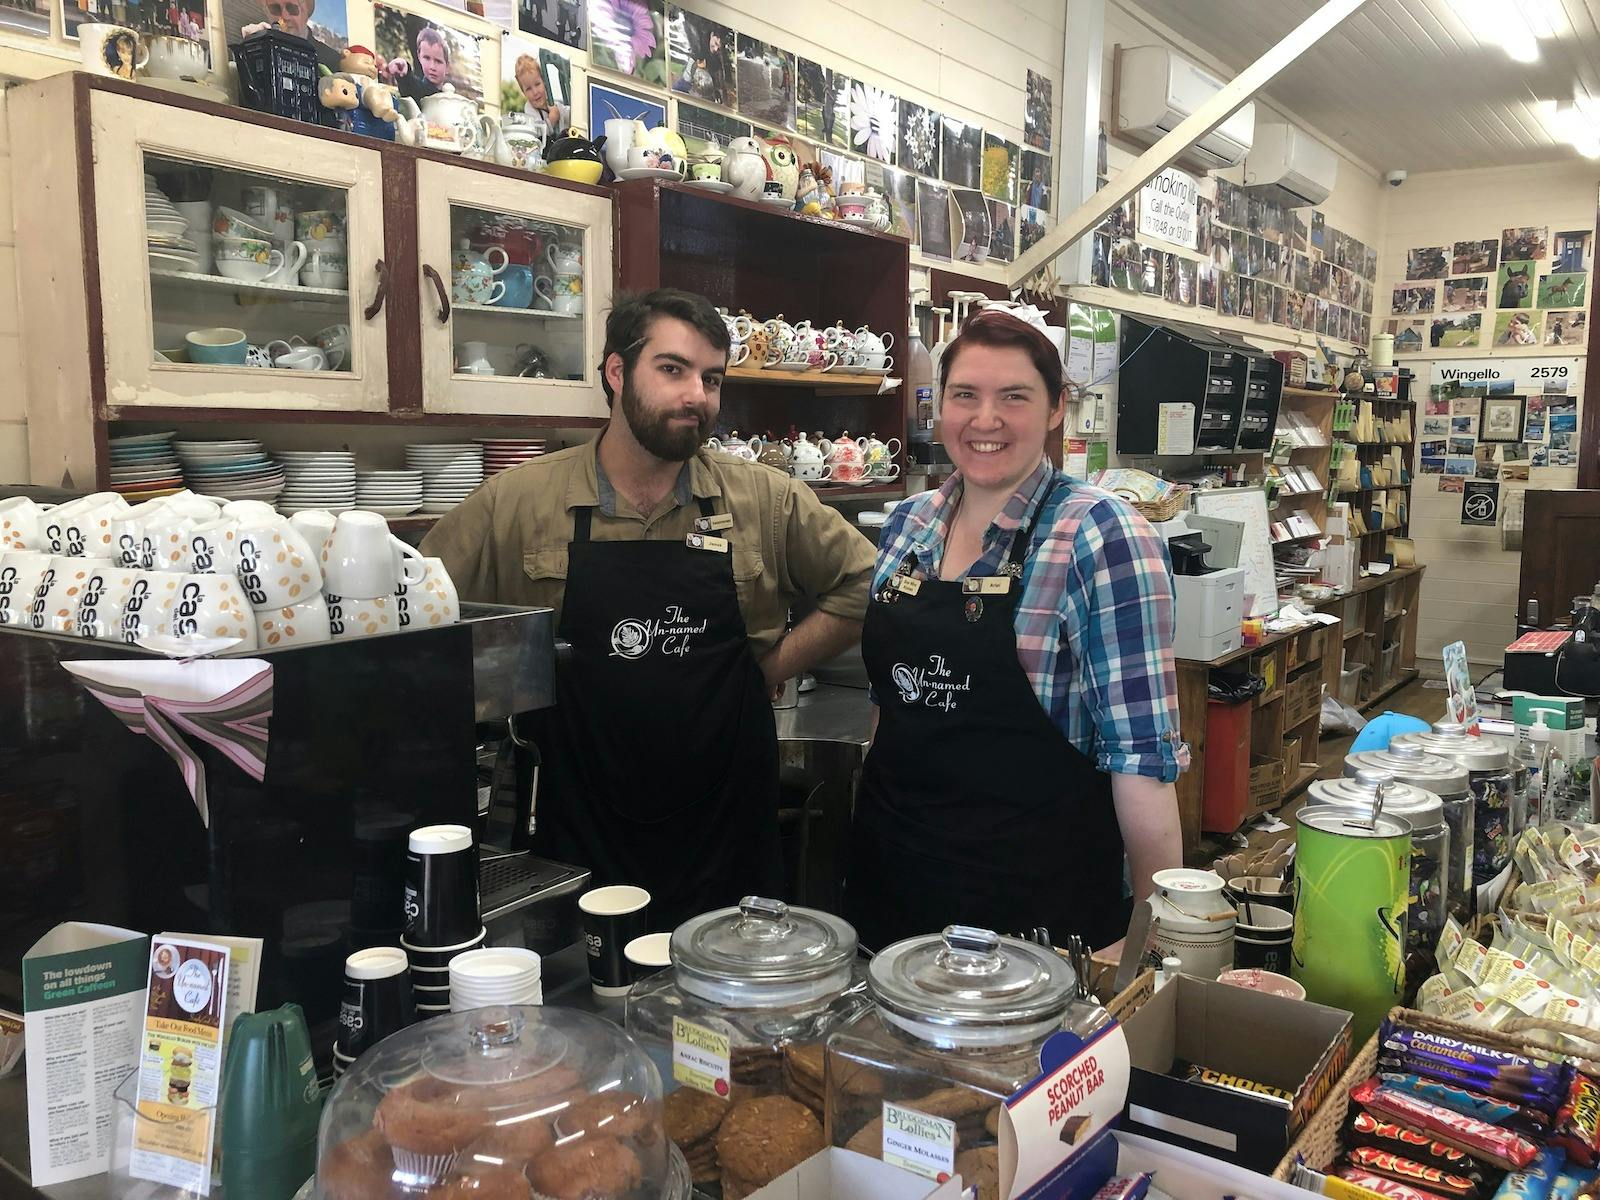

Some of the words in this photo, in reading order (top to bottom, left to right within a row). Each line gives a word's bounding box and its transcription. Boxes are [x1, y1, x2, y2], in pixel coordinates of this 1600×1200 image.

[1151, 198, 1163, 213] Call
[1164, 202, 1175, 217] the
[1441, 368, 1500, 382] Wingello
[1530, 366, 1568, 379] 2579
[240, 539, 267, 605] casa
[32, 569, 55, 629] casa
[81, 575, 103, 640] casa
[178, 582, 200, 635] cas
[125, 579, 148, 643] casa
[664, 605, 690, 624] The
[644, 618, 708, 638] Un-named
[661, 636, 690, 658] Cafe
[928, 654, 951, 678] The
[911, 666, 971, 691] Un-named
[925, 690, 957, 713] Cafe
[43, 970, 63, 981] The
[64, 961, 112, 977] lowdown
[43, 981, 58, 991] on
[58, 977, 72, 988] all
[74, 972, 106, 986] things
[43, 988, 76, 1000] Green
[156, 1020, 169, 1028] Take
[170, 1022, 182, 1031] Out
[183, 1024, 197, 1034] Food
[197, 1027, 213, 1038] Menu
[686, 1032, 716, 1053] Lollies
[1409, 1038, 1476, 1064] Caramello
[1412, 1029, 1463, 1049] DAIRY
[1462, 1042, 1503, 1060] MILK
[1047, 1055, 1097, 1106] SCORCHED
[1048, 1084, 1084, 1127] PEANUT
[1086, 1068, 1105, 1095] BAR
[900, 1120, 936, 1141] Lollies
[886, 1137, 912, 1151] GINGER
[914, 1146, 950, 1163] MOLASSES
